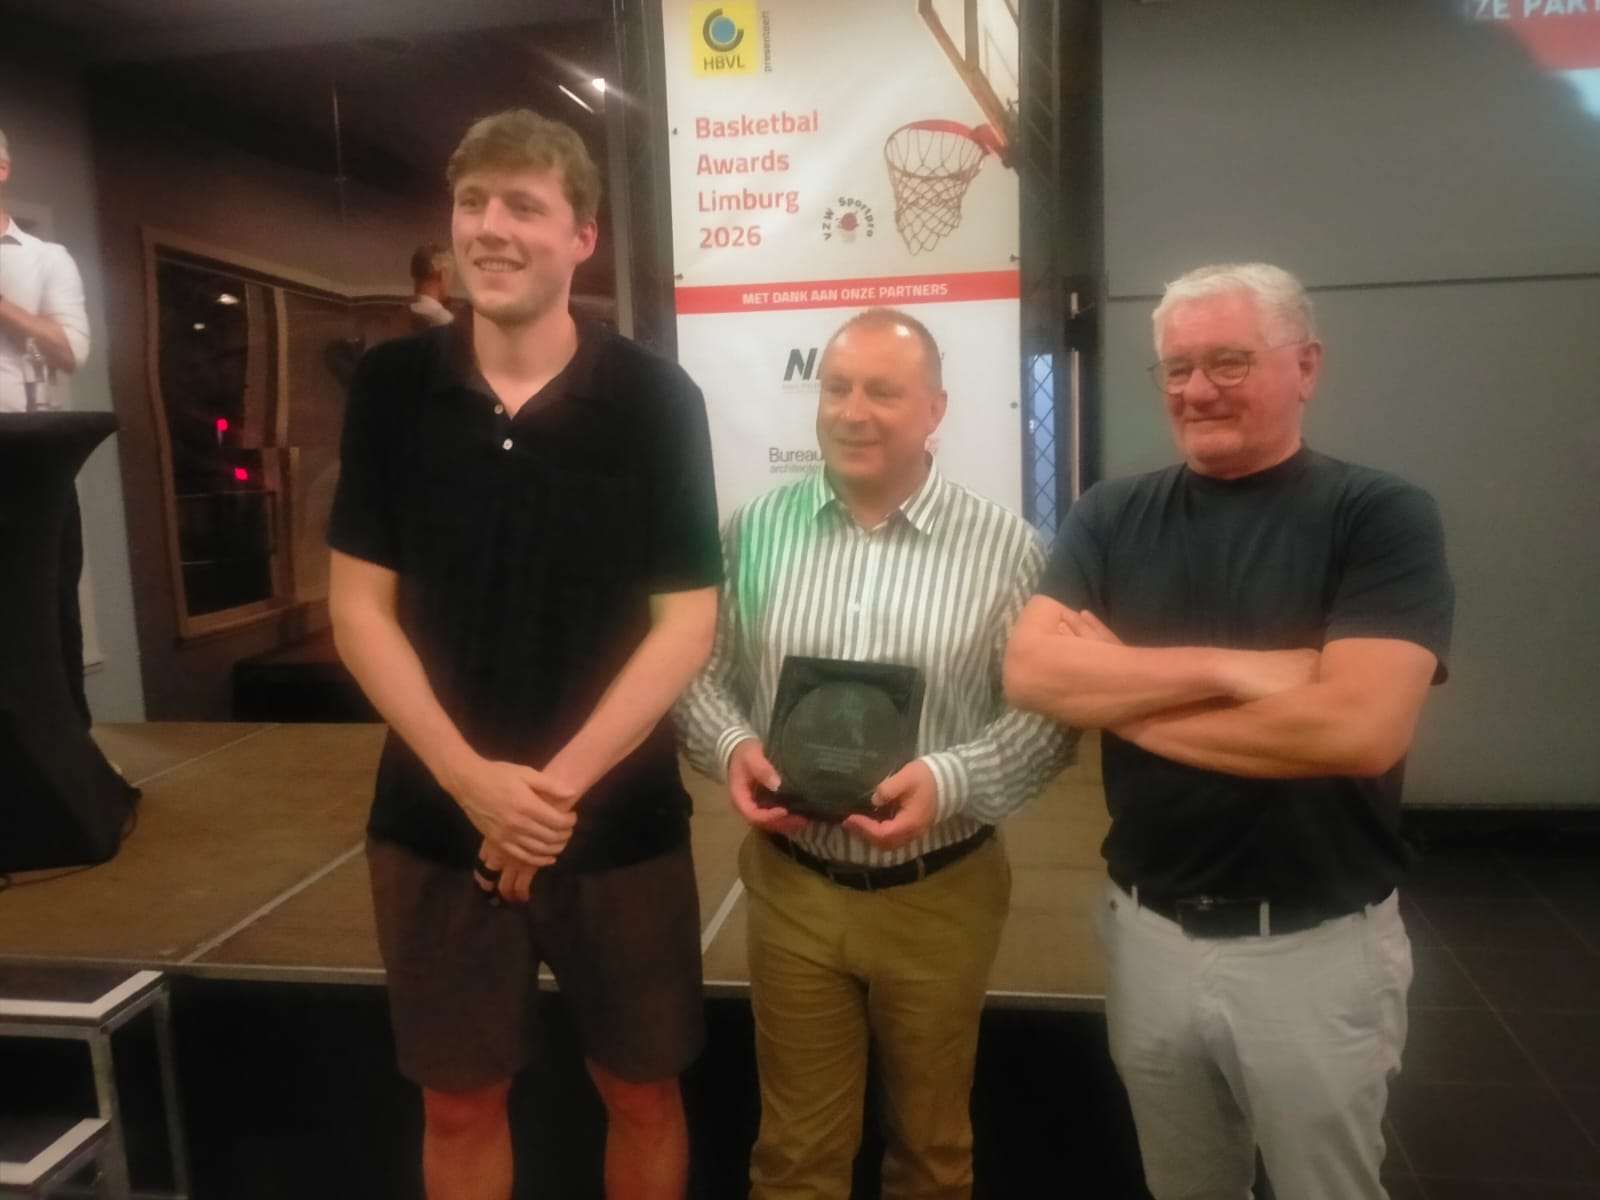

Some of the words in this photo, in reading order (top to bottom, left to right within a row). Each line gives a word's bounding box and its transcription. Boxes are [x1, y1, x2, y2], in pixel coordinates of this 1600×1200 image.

[1523, 0, 1600, 18] PAR
[703, 55, 745, 71] HBVL
[695, 110, 819, 139] Basketbal
[696, 150, 790, 175] Awards
[698, 188, 799, 213] Limburg
[700, 226, 762, 249] 2026
[742, 293, 769, 305] MET
[773, 291, 808, 303] DANK
[811, 289, 838, 301] AAN
[841, 287, 876, 300] ONZE
[879, 283, 948, 298] PARTNERS
[769, 447, 823, 462] Bureau
